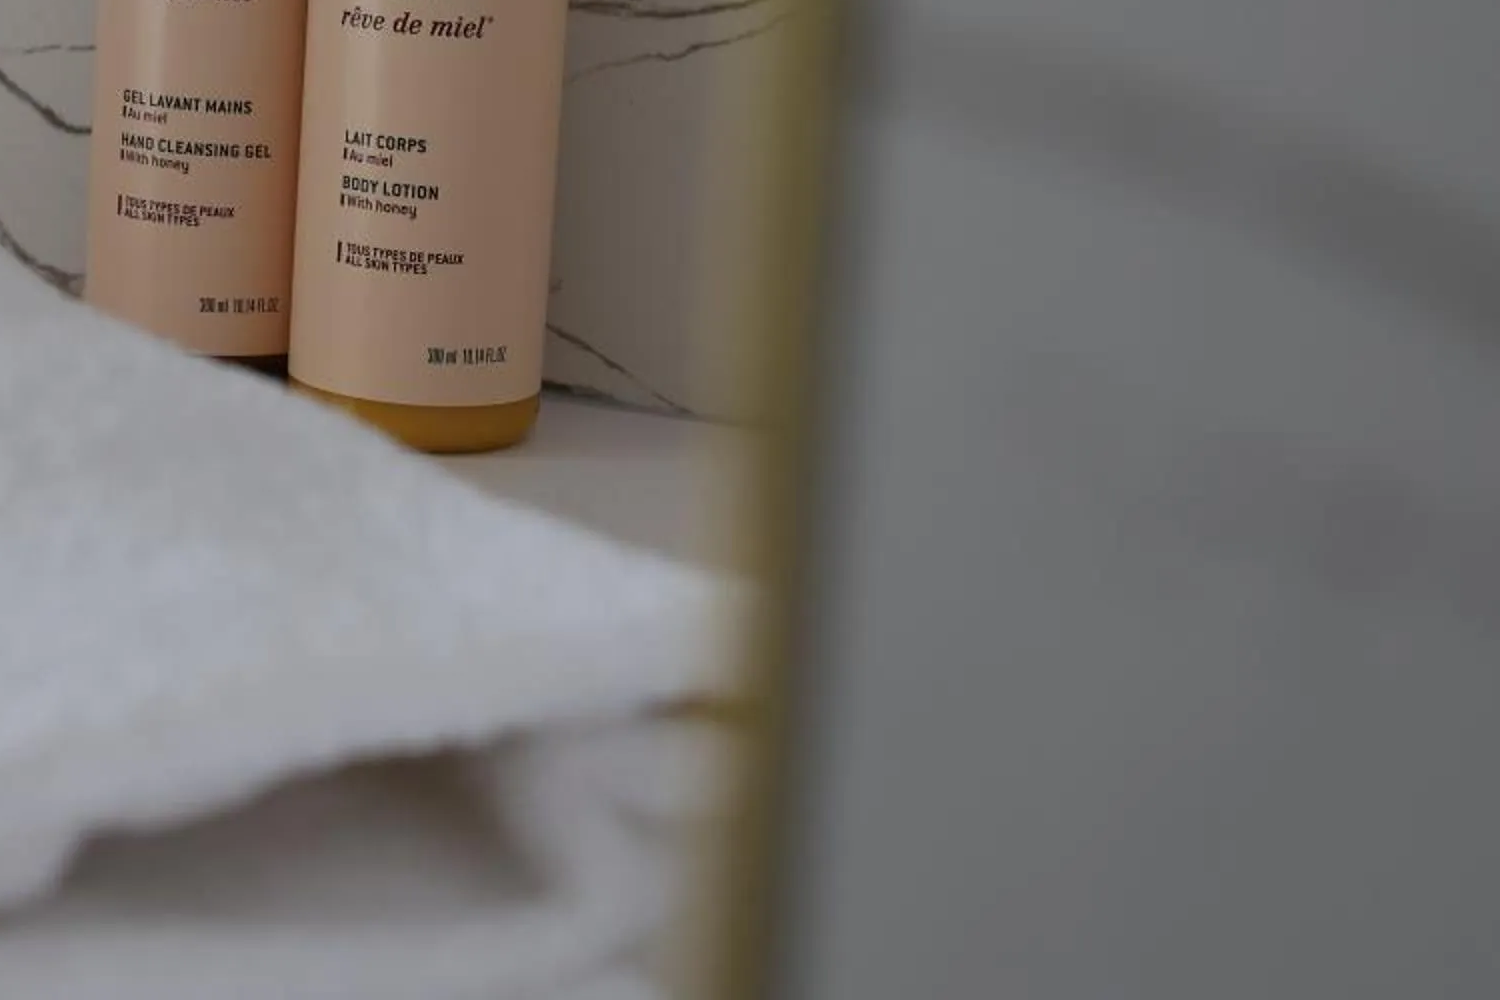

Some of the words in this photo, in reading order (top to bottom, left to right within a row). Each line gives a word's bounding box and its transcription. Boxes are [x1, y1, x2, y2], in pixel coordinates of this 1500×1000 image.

[341, 7, 385, 31] rêve
[393, 12, 423, 36] de
[123, 89, 146, 104] GEL
[149, 93, 201, 113] LAVANT
[205, 100, 254, 116] MAINS
[121, 132, 154, 150] HAND
[158, 138, 240, 158] CLEANSING
[245, 144, 272, 159] GEL
[345, 129, 372, 147] LAIT
[377, 135, 428, 153] CORPS
[151, 155, 190, 174] honey
[342, 175, 379, 194] BODY
[383, 182, 440, 201] LOTION
[348, 195, 374, 211] With
[376, 198, 418, 220] honey
[346, 255, 363, 267] ALL
[365, 258, 389, 272] SKIN
[392, 261, 428, 275] TYPES
[347, 242, 370, 257] TOUS
[373, 246, 407, 262] TYPES
[409, 250, 425, 263] DE
[427, 253, 465, 265] PEAUX
